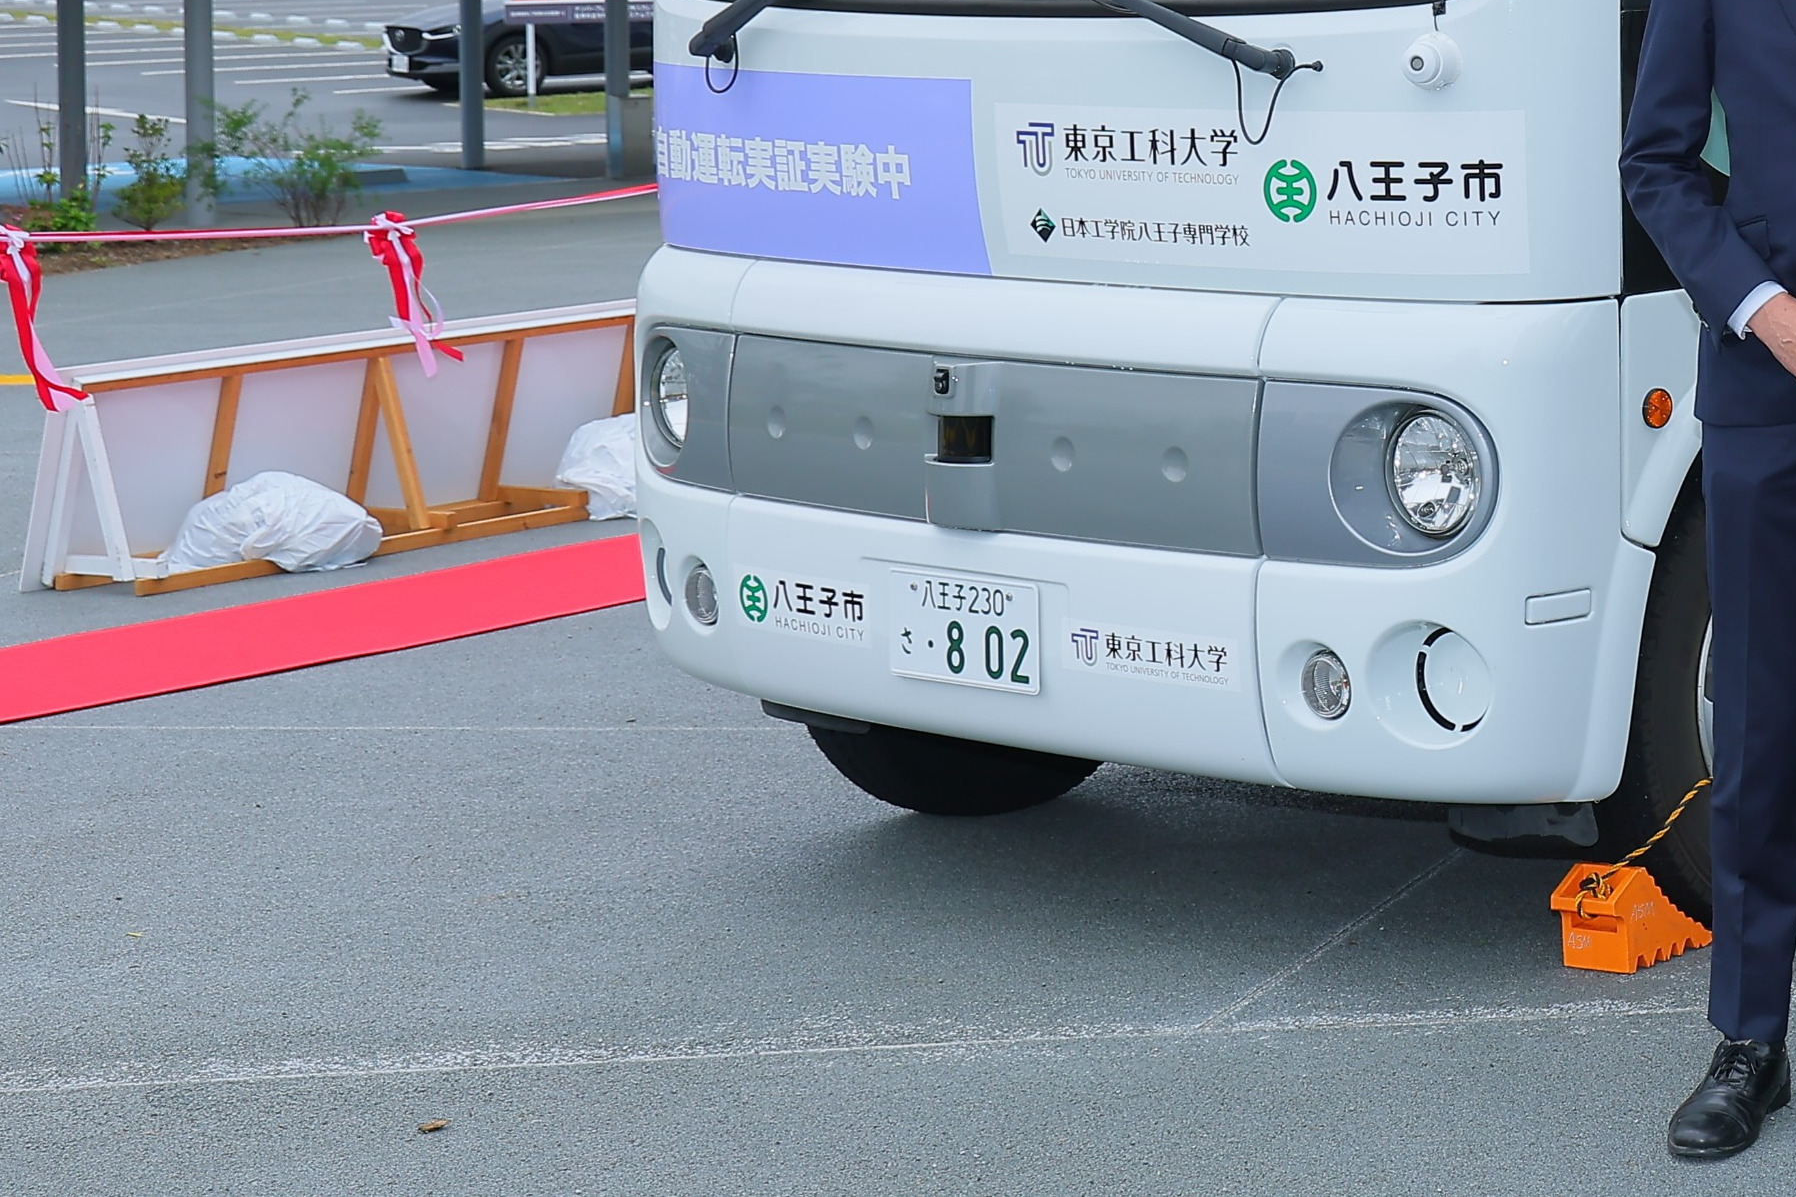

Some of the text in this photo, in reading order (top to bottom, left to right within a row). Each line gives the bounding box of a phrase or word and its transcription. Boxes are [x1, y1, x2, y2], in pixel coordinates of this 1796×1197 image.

[655, 125, 912, 200] 自動運転実証実験中
[1063, 124, 1238, 167] 東京工科大学
[1065, 167, 1239, 185] TOKYO UNIVERSITY OF TECHNOLOGY
[1327, 160, 1503, 202] 八王子市
[1061, 217, 1250, 246] 日本工学院八王子専門学校
[1329, 210, 1501, 227] HACHIOJI CITY
[773, 580, 864, 622] 八王子市
[775, 616, 864, 641] HACHIOJI CITY
[1105, 632, 1228, 672] 東京工科大学
[1106, 661, 1229, 685] TOKYO UNIVERSITY OF TECHNOLOGY
